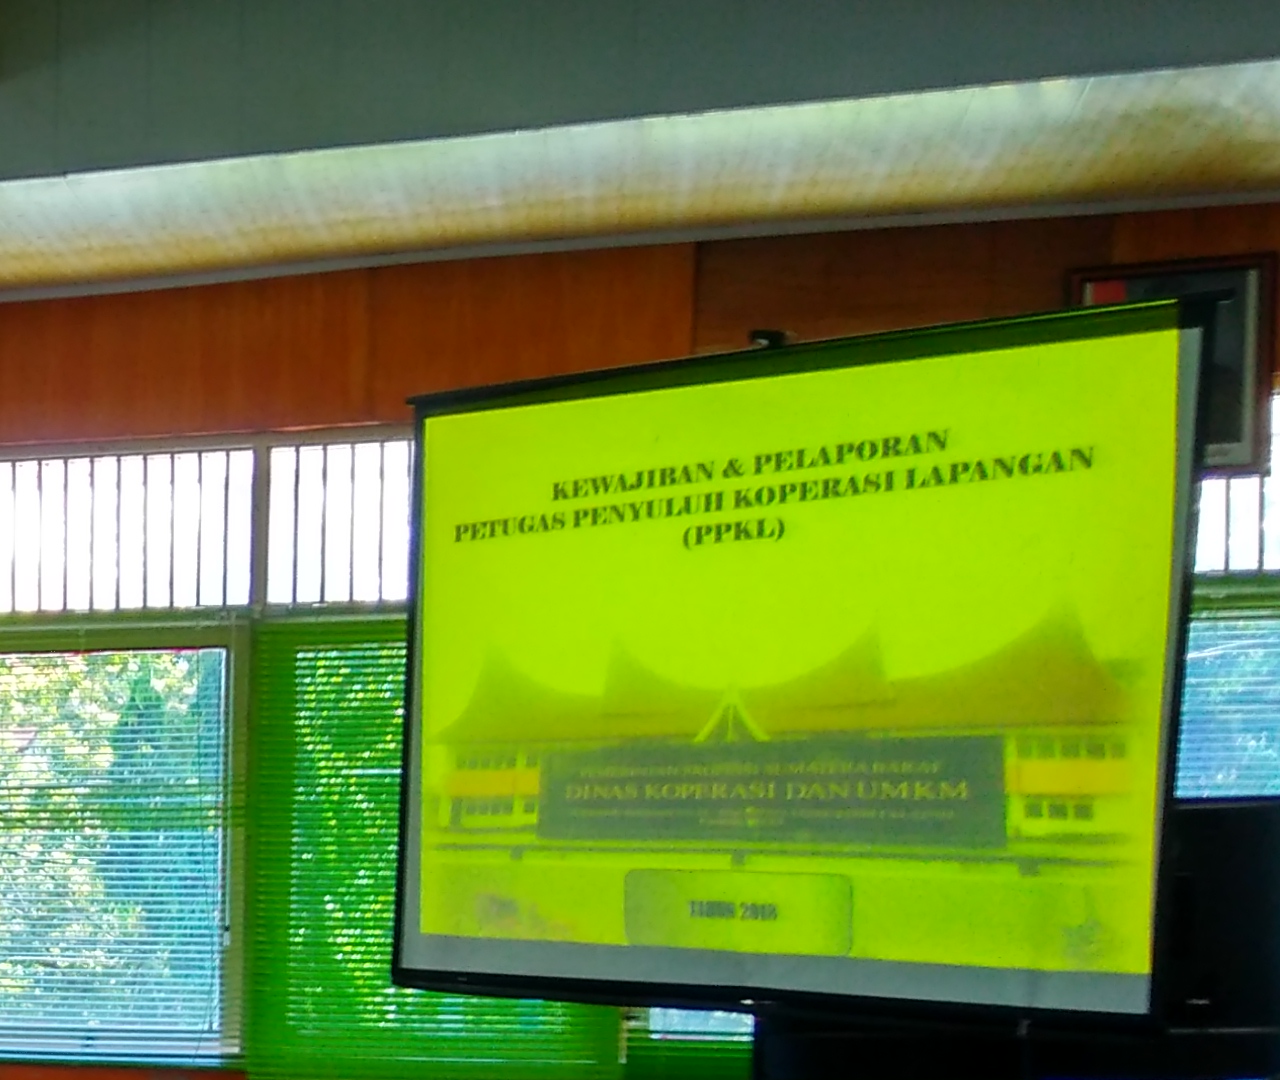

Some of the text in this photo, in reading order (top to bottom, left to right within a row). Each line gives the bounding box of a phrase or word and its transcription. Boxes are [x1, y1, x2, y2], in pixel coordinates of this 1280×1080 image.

[551, 428, 950, 501] KEWAJIBAN & PELAPORAN
[454, 446, 1095, 542] PETUGAS PENYULUH KOPERASI LAPANGAN
[682, 516, 786, 550] (PPKL)
[565, 779, 968, 800] DINAS KOPERASI DAN UMKM
